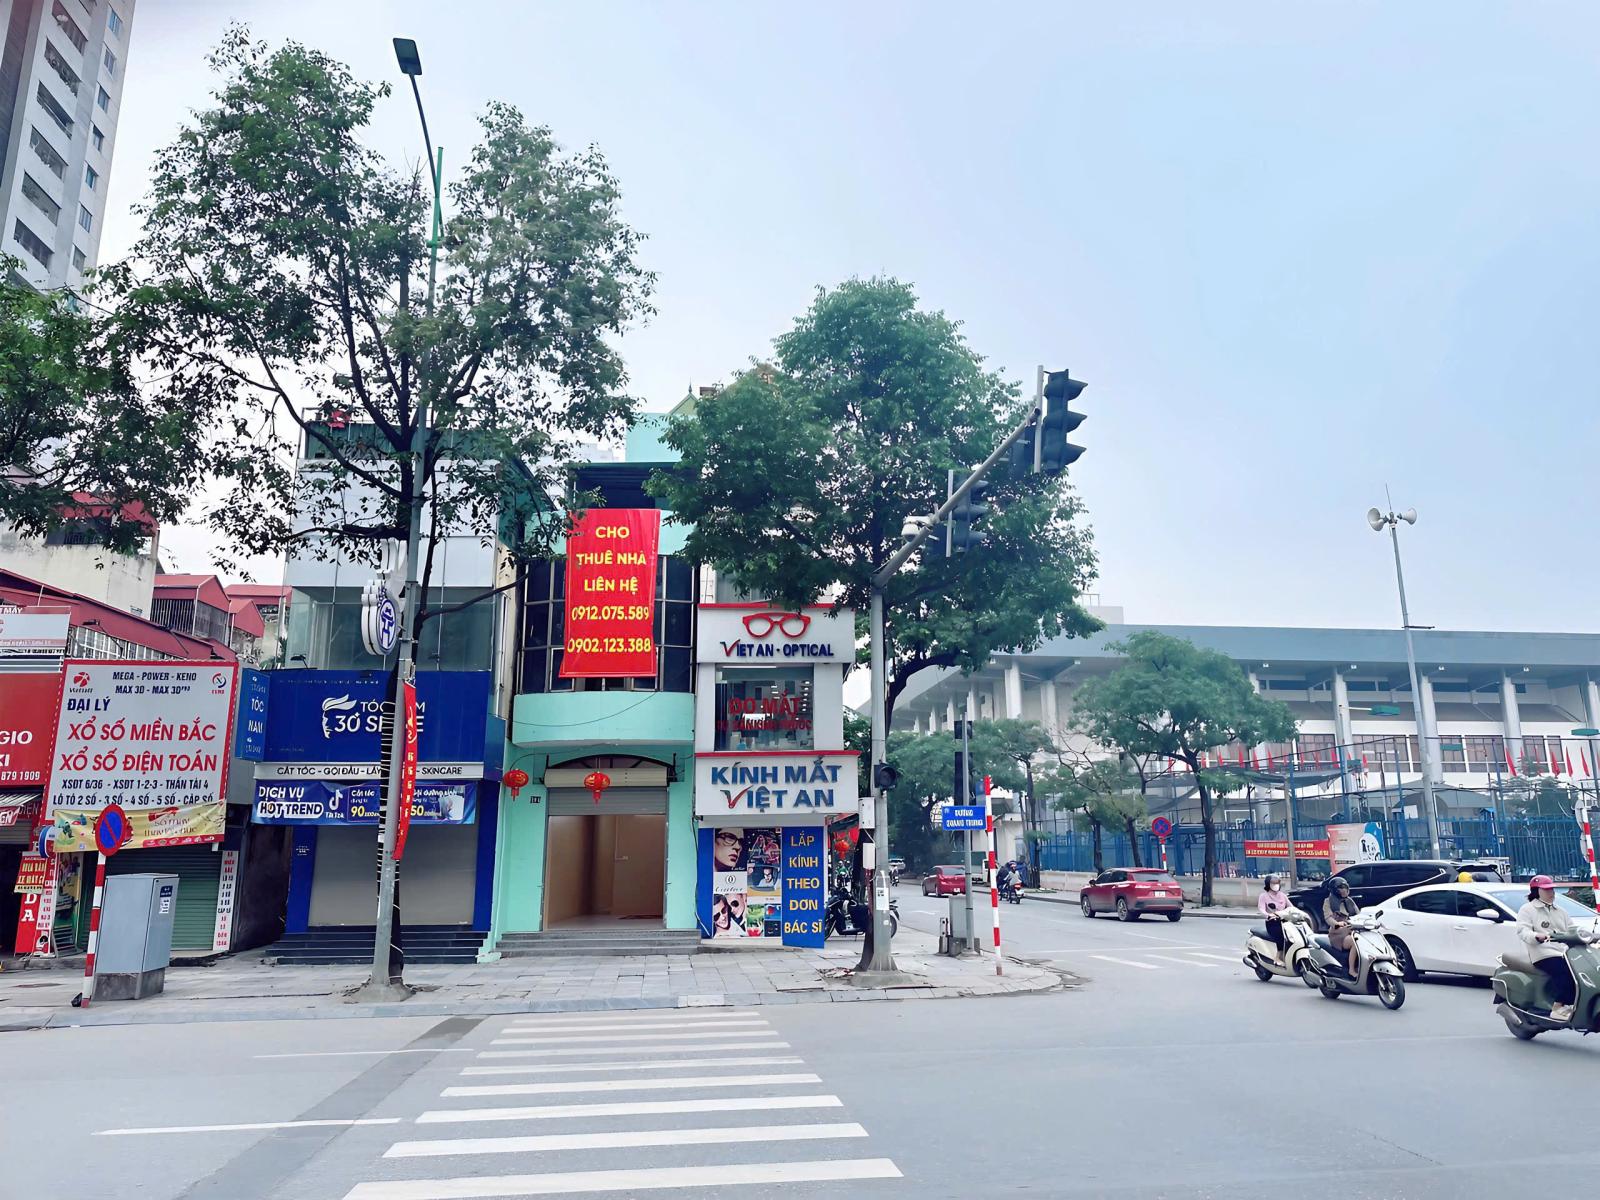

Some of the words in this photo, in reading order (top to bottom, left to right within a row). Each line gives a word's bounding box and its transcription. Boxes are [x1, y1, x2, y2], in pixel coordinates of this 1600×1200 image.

[595, 526, 630, 539] CHO
[576, 550, 613, 566] THUÊ
[584, 576, 615, 591] LIÊN
[620, 576, 639, 595] HỆ
[572, 605, 650, 621] 0912.075.589
[567, 637, 651, 653] 0902.123.388
[720, 639, 754, 657] VIET
[756, 643, 774, 656] AN
[783, 643, 834, 656] OPTICAL
[112, 672, 134, 681] MEGA
[142, 672, 169, 681] POWER
[176, 672, 197, 681] KENO
[115, 685, 133, 694] MAX
[152, 685, 169, 694] MAX
[67, 698, 90, 713] ĐẠI
[94, 696, 111, 711] LÝ
[67, 715, 97, 741] XỔ
[100, 717, 127, 741] SỐ
[130, 717, 174, 741] MIỀN
[179, 716, 217, 741] BẮC
[334, 714, 361, 733] 30
[59, 746, 89, 771] XỔ
[92, 748, 118, 772] SỐ
[122, 750, 164, 775] ĐIỆN
[169, 749, 218, 771] TOÁN
[421, 766, 463, 775] SKINCARE
[711, 761, 778, 785] KÍNH
[784, 754, 842, 784] MẮT
[85, 779, 103, 789] 6/36
[203, 780, 209, 789] 4
[77, 795, 83, 805] 2
[85, 792, 98, 805] SỐ
[111, 792, 124, 805] SỐ
[130, 795, 136, 805] 4
[138, 792, 151, 805] SỐ
[156, 795, 163, 805] 5
[164, 792, 176, 805] SỐ
[258, 786, 286, 804] DỊCH
[289, 786, 305, 802] VỤ
[720, 785, 788, 813] VIỆT
[793, 788, 834, 808] AN
[285, 803, 323, 816] TREND
[790, 831, 815, 847] LẮP
[789, 854, 818, 868] KÍNH
[786, 878, 820, 890] THEO
[784, 919, 808, 934] BÁC
[811, 919, 823, 933] SĨ
